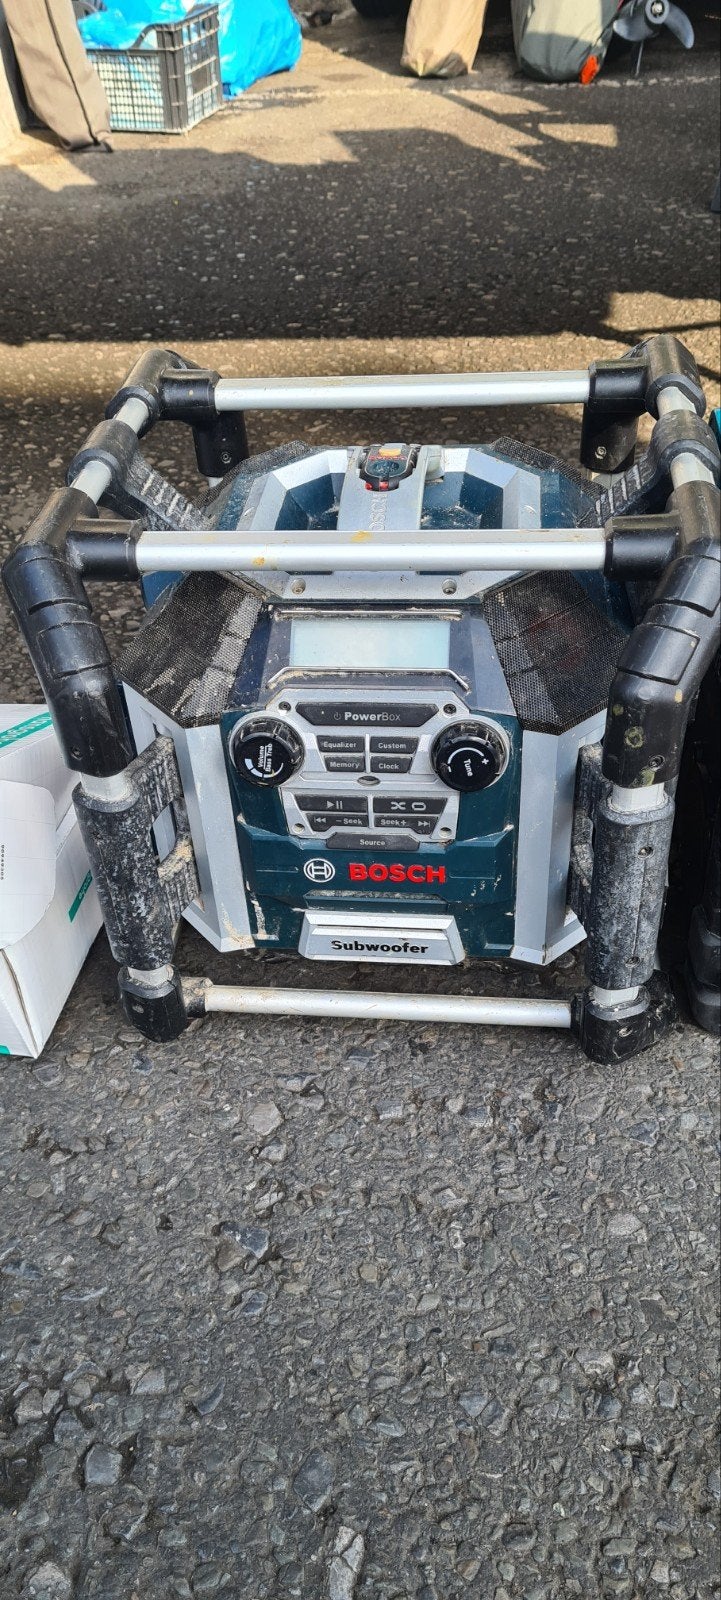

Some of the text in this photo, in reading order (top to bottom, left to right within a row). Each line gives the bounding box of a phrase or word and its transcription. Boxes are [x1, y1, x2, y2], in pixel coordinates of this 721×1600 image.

[344, 711, 401, 721] PowerBox
[323, 741, 356, 749] Equalizer
[329, 761, 360, 769] Memory
[463, 758, 474, 777] Tune
[348, 863, 446, 884] BOSCH
[331, 940, 429, 954] Subwoofer
